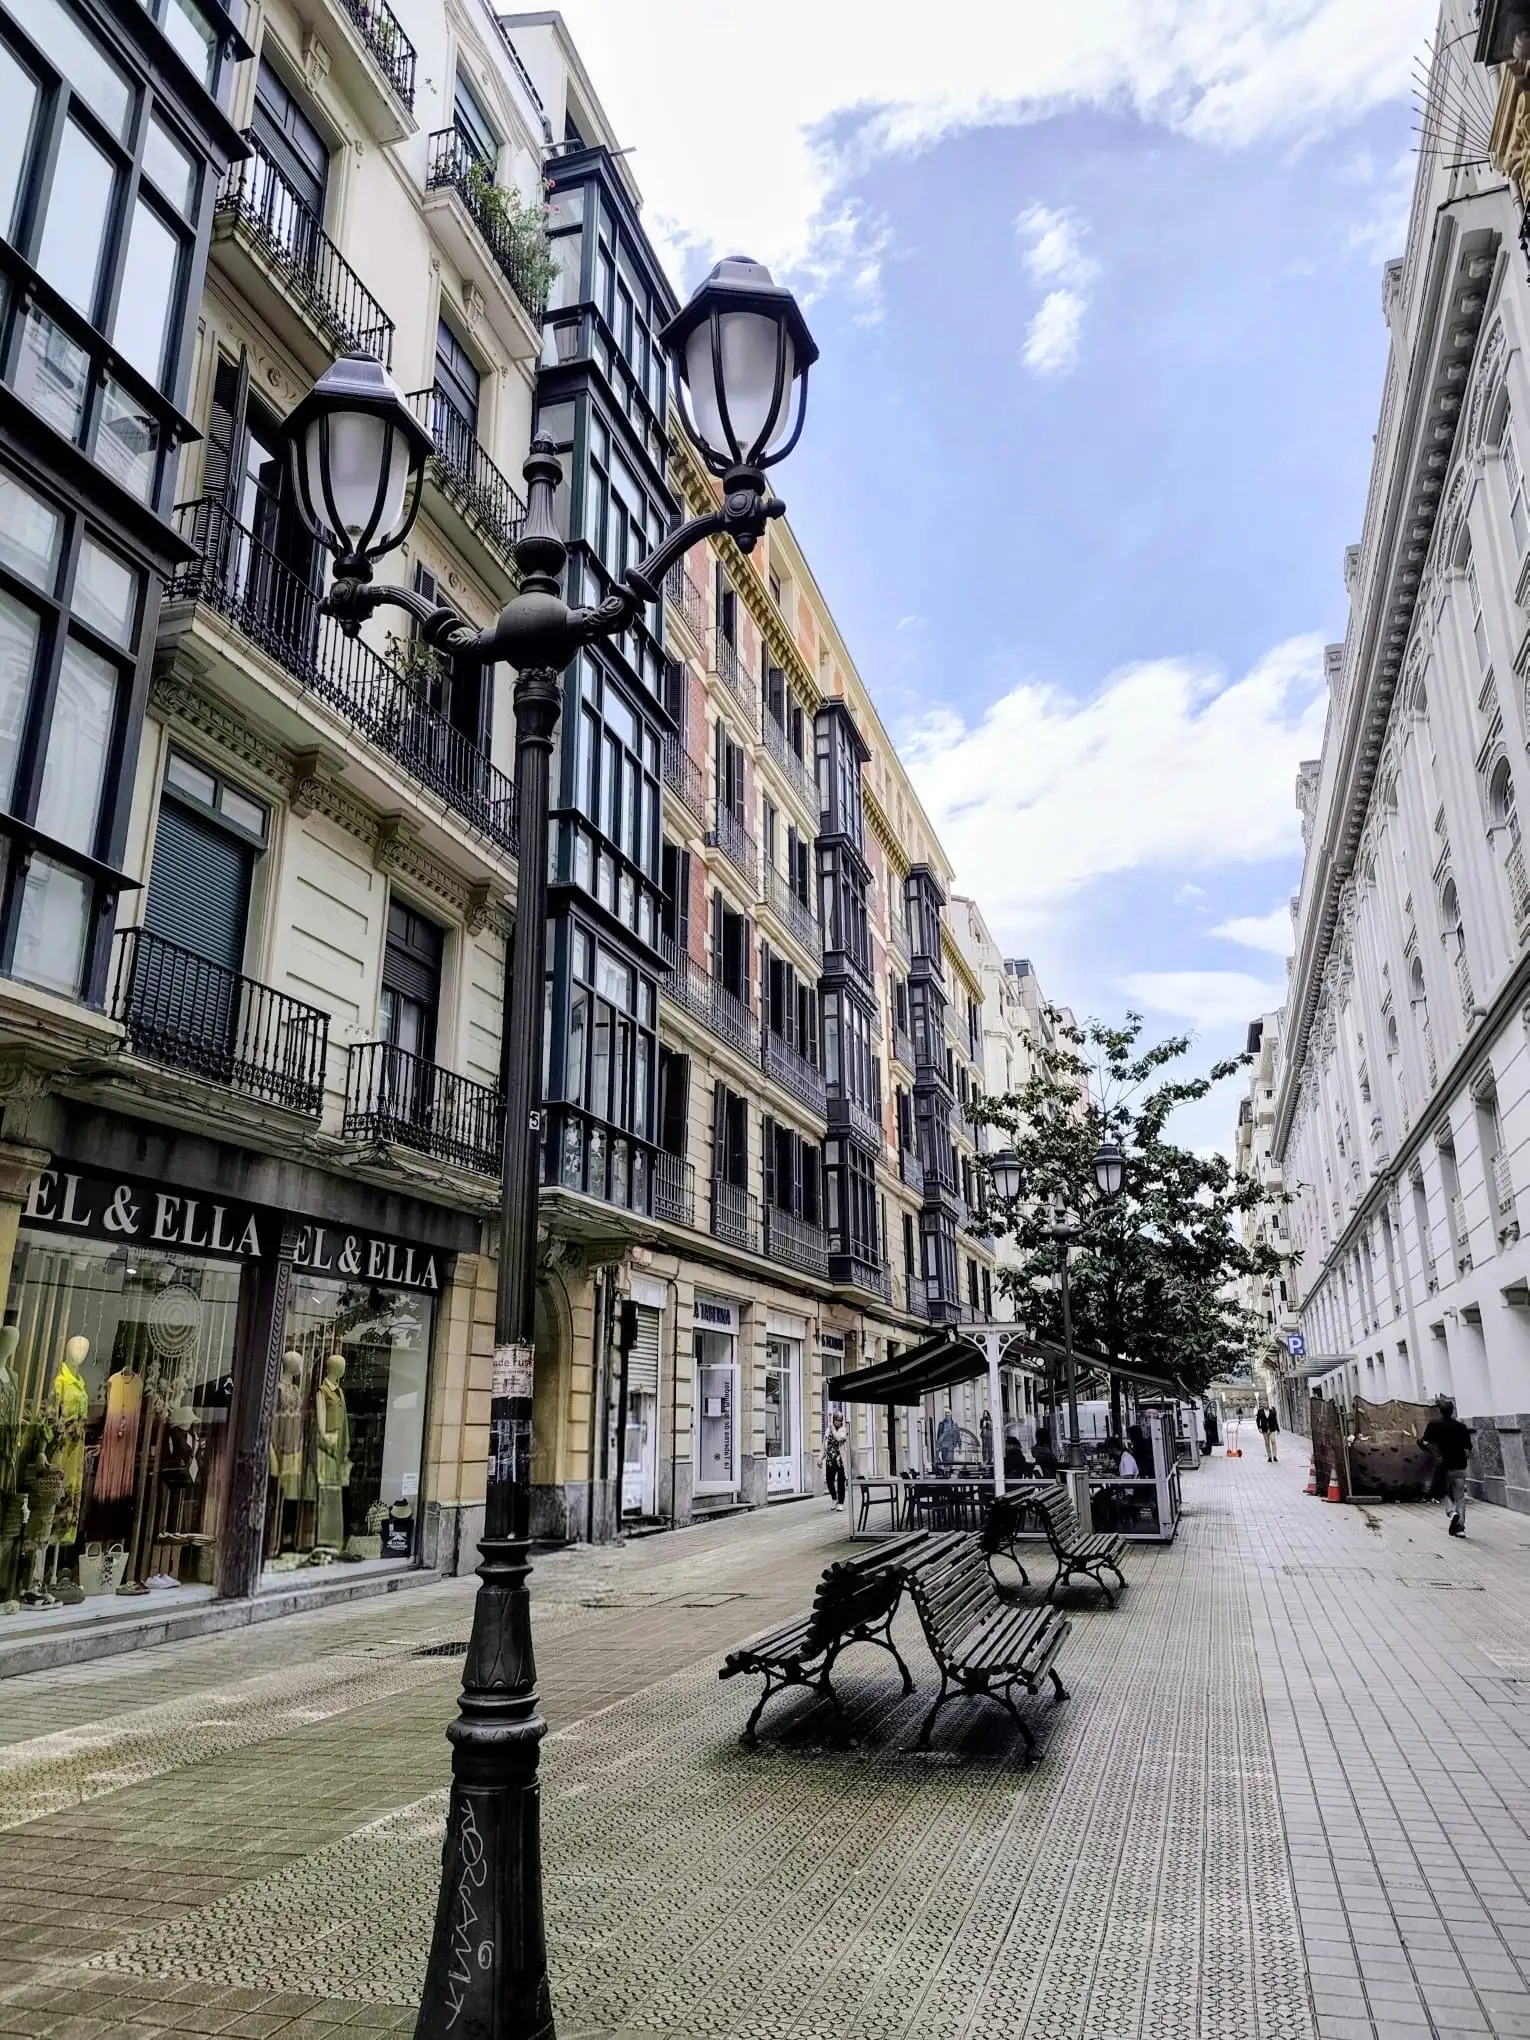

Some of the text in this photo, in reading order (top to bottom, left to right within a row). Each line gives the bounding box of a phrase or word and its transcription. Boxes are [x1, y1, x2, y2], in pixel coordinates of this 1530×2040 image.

[20, 1169, 262, 1257] EL & ELLA
[293, 1225, 439, 1289] EL & ELLA
[1288, 1337, 1303, 1354] P
